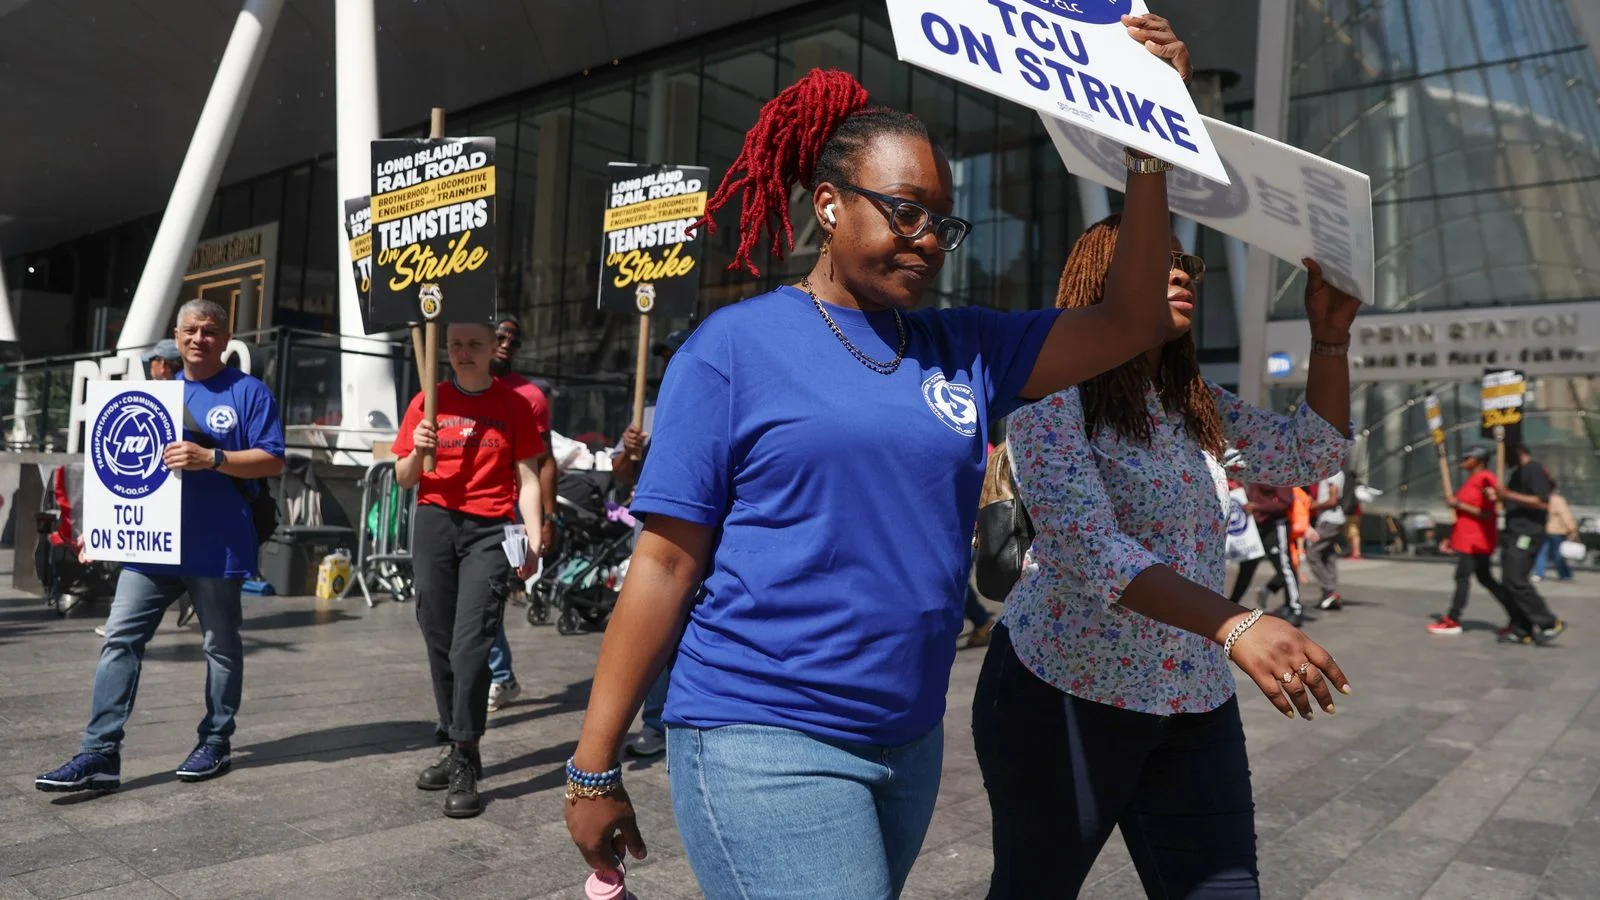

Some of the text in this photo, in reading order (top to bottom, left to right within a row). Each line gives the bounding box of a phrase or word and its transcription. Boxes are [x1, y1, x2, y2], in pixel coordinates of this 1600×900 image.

[986, 0, 1089, 65] TCU
[920, 12, 1199, 154] ON STRIKE
[376, 151, 487, 195] RAIL ROAD
[377, 142, 463, 177] LONG ISLAND
[378, 186, 429, 208] BROTHERHOOD
[437, 172, 487, 191] LOCOMOTIVE
[611, 179, 701, 208] RAIL ROAD
[612, 170, 683, 195] LONG ISLAND
[378, 199, 425, 218] ENGINEERS
[437, 183, 487, 202] TRAINMEN
[658, 205, 698, 217] TRAINMEN
[378, 199, 488, 250] TEAMSTERS
[389, 231, 488, 291] Strike
[613, 242, 695, 288] Strike
[1360, 314, 1578, 345] PENN STATION
[94, 400, 120, 471] TRANSPORTATION
[122, 396, 173, 440] COMMUNICATIONS
[121, 435, 149, 453] TCU
[114, 505, 143, 526] TCU
[91, 528, 172, 553] ON STRIKE
